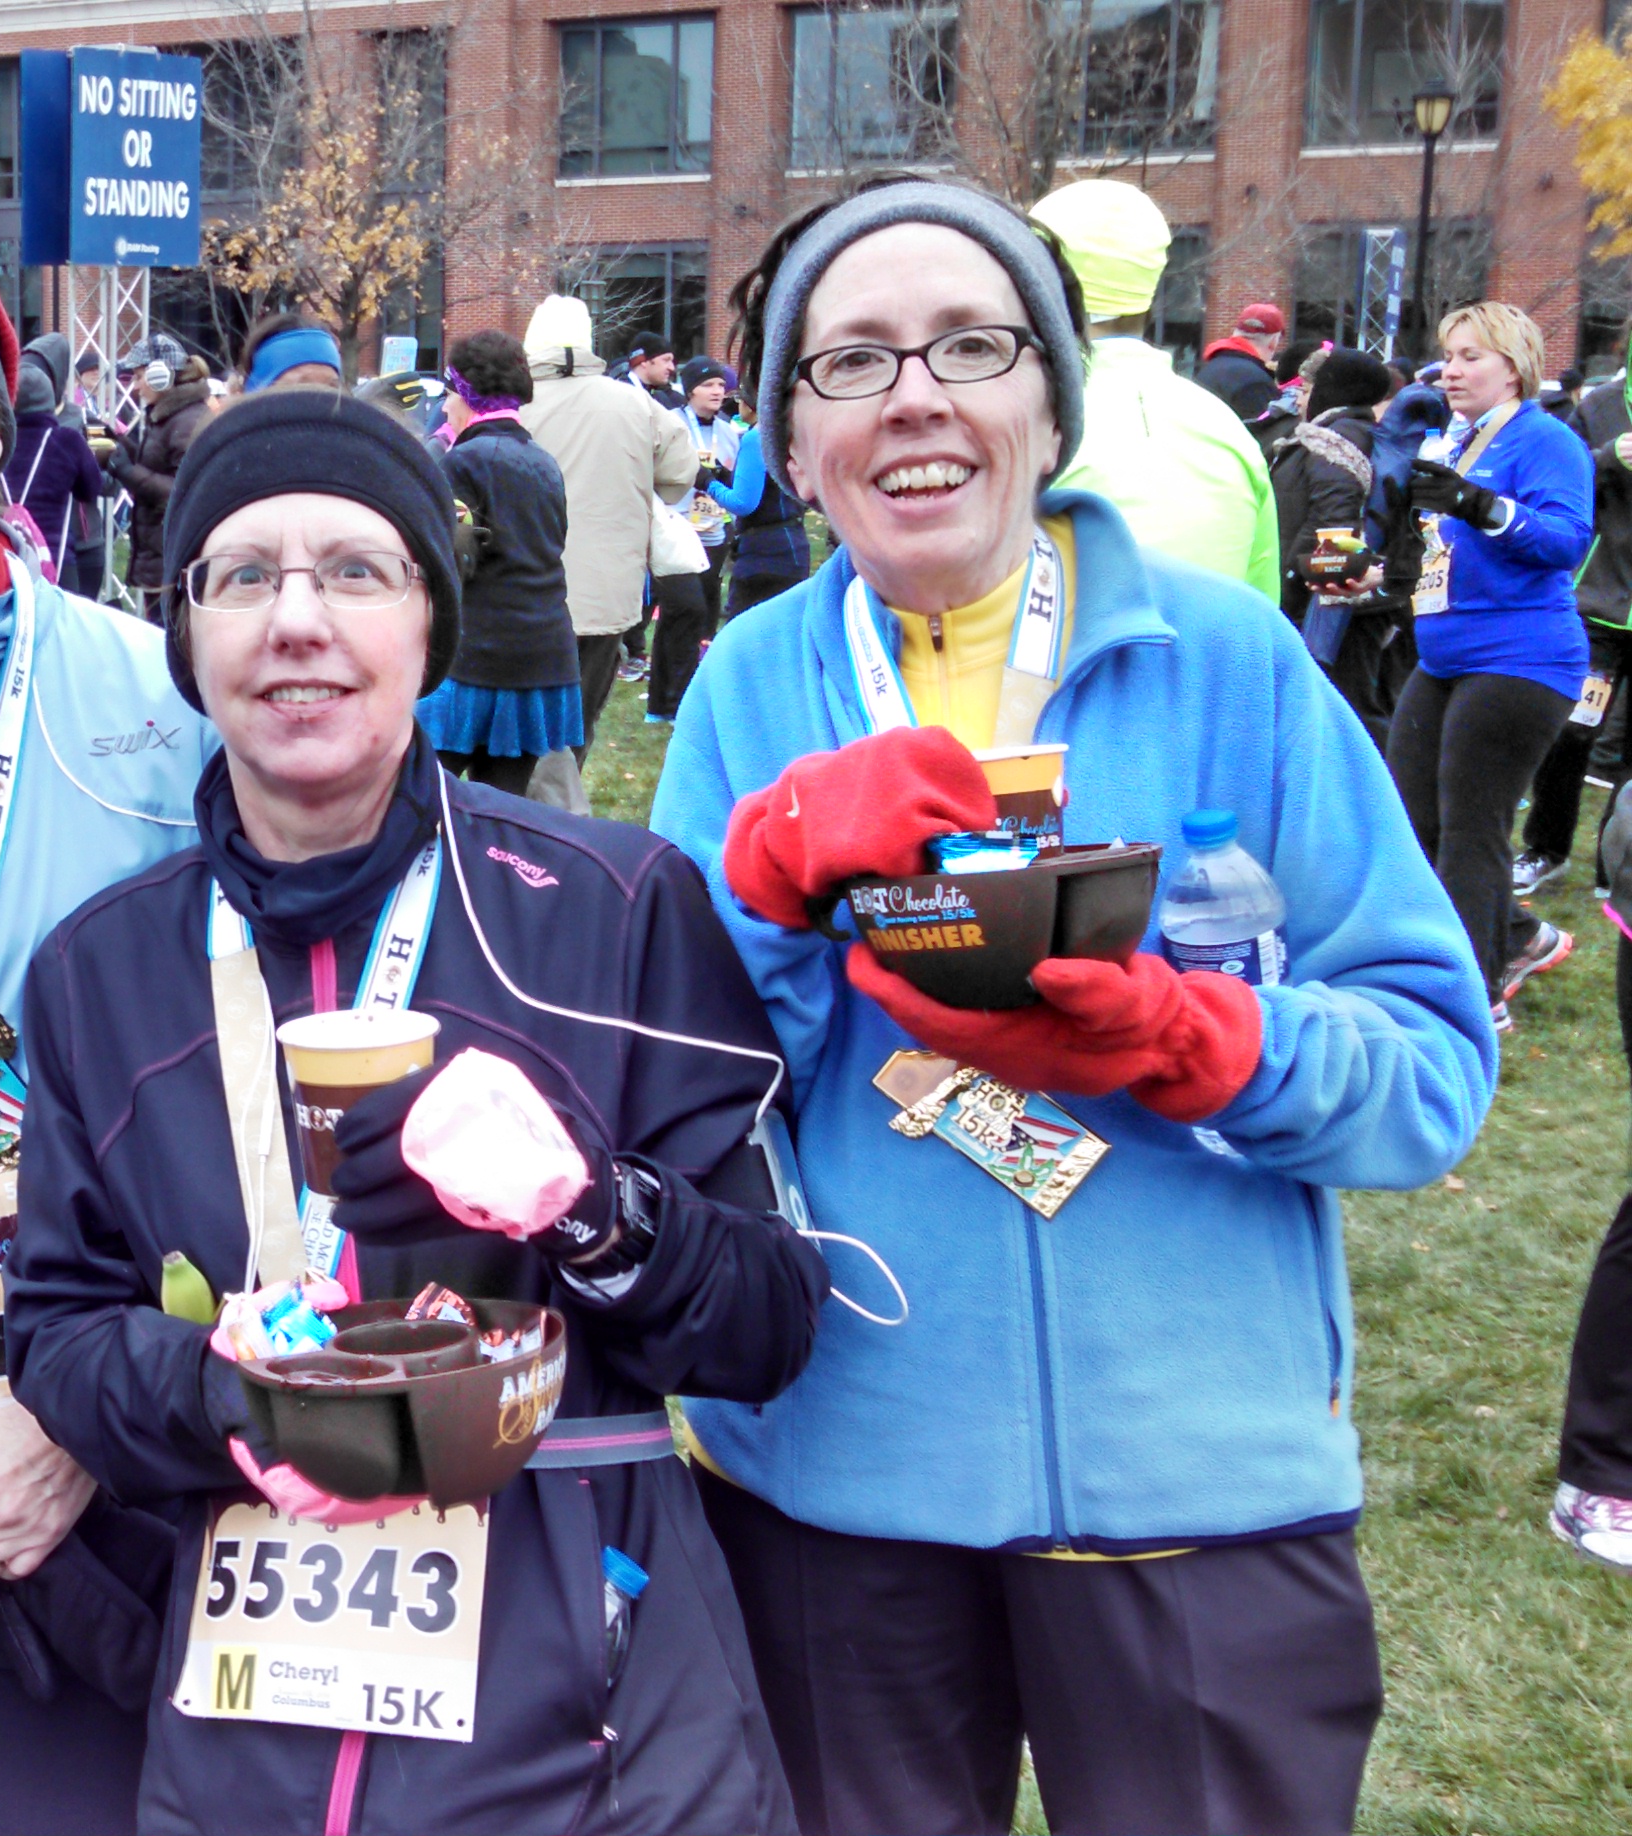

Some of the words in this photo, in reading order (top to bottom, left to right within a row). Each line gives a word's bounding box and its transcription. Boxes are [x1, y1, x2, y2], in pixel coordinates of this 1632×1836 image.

[79, 75, 114, 115] NO
[119, 78, 197, 121] SITTING
[123, 129, 153, 168] OR
[83, 177, 190, 219] STANDING
[870, 663, 888, 698] 15k
[487, 847, 547, 879] saucony
[850, 886, 889, 914] HOT
[889, 883, 971, 913] Chocolate
[867, 924, 986, 951] FINISHER
[206, 1539, 460, 1634] 55343
[215, 1653, 257, 1711] M
[269, 1660, 339, 1686] Cheryl
[362, 1683, 445, 1730] 15K
[271, 1695, 331, 1709] Columbus
